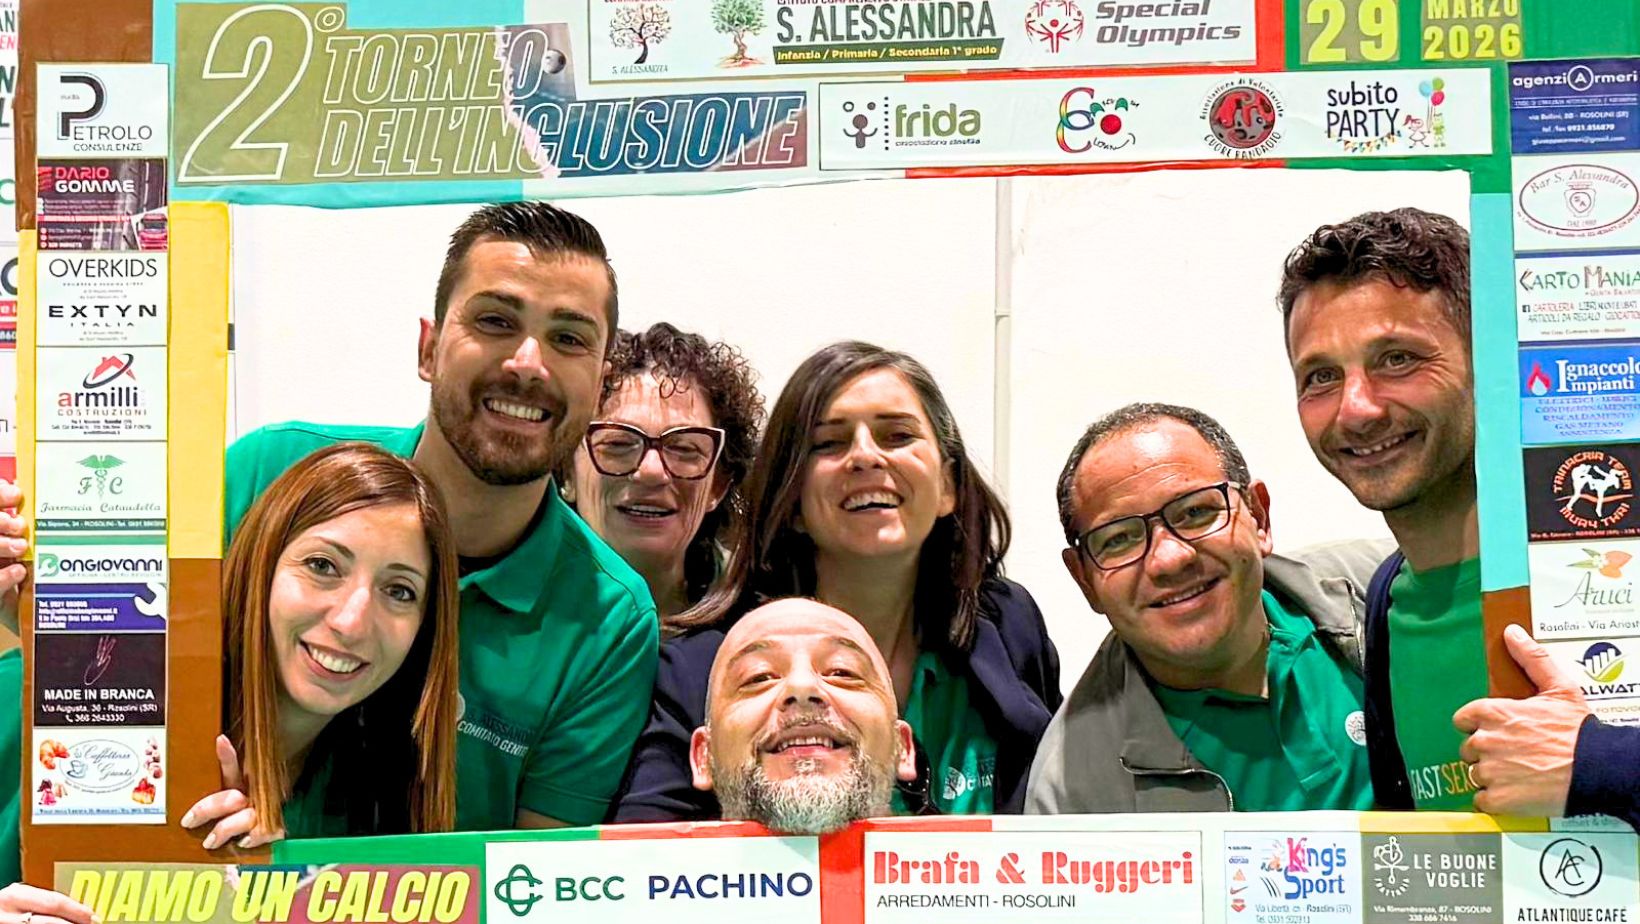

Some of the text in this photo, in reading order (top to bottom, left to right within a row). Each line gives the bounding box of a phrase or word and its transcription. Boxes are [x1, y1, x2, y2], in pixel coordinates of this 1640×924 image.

[1096, 0, 1210, 23] Special
[1427, 0, 1518, 20] MARZO
[777, 1, 997, 43] S. ALESSANDRA
[1306, 0, 1398, 62] 29
[1096, 23, 1241, 47] Olympics
[1424, 23, 1521, 59] 2026
[778, 51, 821, 61] Infanzia
[832, 48, 878, 59] Primaria
[889, 46, 949, 57] Secondaria
[964, 45, 997, 56] grado
[322, 29, 549, 104] TORNEO
[1327, 81, 1397, 106] subito
[896, 103, 981, 137] frida
[1327, 108, 1400, 138] PARTY
[73, 143, 143, 151] CONSULENZE
[55, 166, 109, 179] DARIO
[55, 180, 135, 193] GOMME
[1529, 179, 1551, 194] Bar
[49, 258, 157, 278] OVERKIDS
[48, 304, 157, 318] EXTYN
[58, 387, 138, 407] armilli
[1554, 571, 1633, 608] Aruci
[1540, 621, 1579, 632] Rosolini
[1588, 620, 1606, 630] Via
[44, 689, 154, 700] MADE IN BRANCA
[42, 704, 55, 712] Via
[1287, 837, 1346, 876] King's
[1414, 853, 1496, 870] LE BUONE
[874, 851, 980, 884] Brafa
[996, 852, 1026, 884] &
[1042, 851, 1193, 893] Ruggeri
[1284, 865, 1345, 900] Sport
[1426, 872, 1485, 888] VOGLIE
[68, 870, 470, 923] DIAMO UN CALCIO
[555, 876, 625, 901] BCC
[648, 872, 813, 900] PACHINO
[877, 894, 990, 908] ARREDAMENTI
[1002, 894, 1076, 908] ROSOLINI
[1518, 907, 1593, 922] ATLANTIQUE
